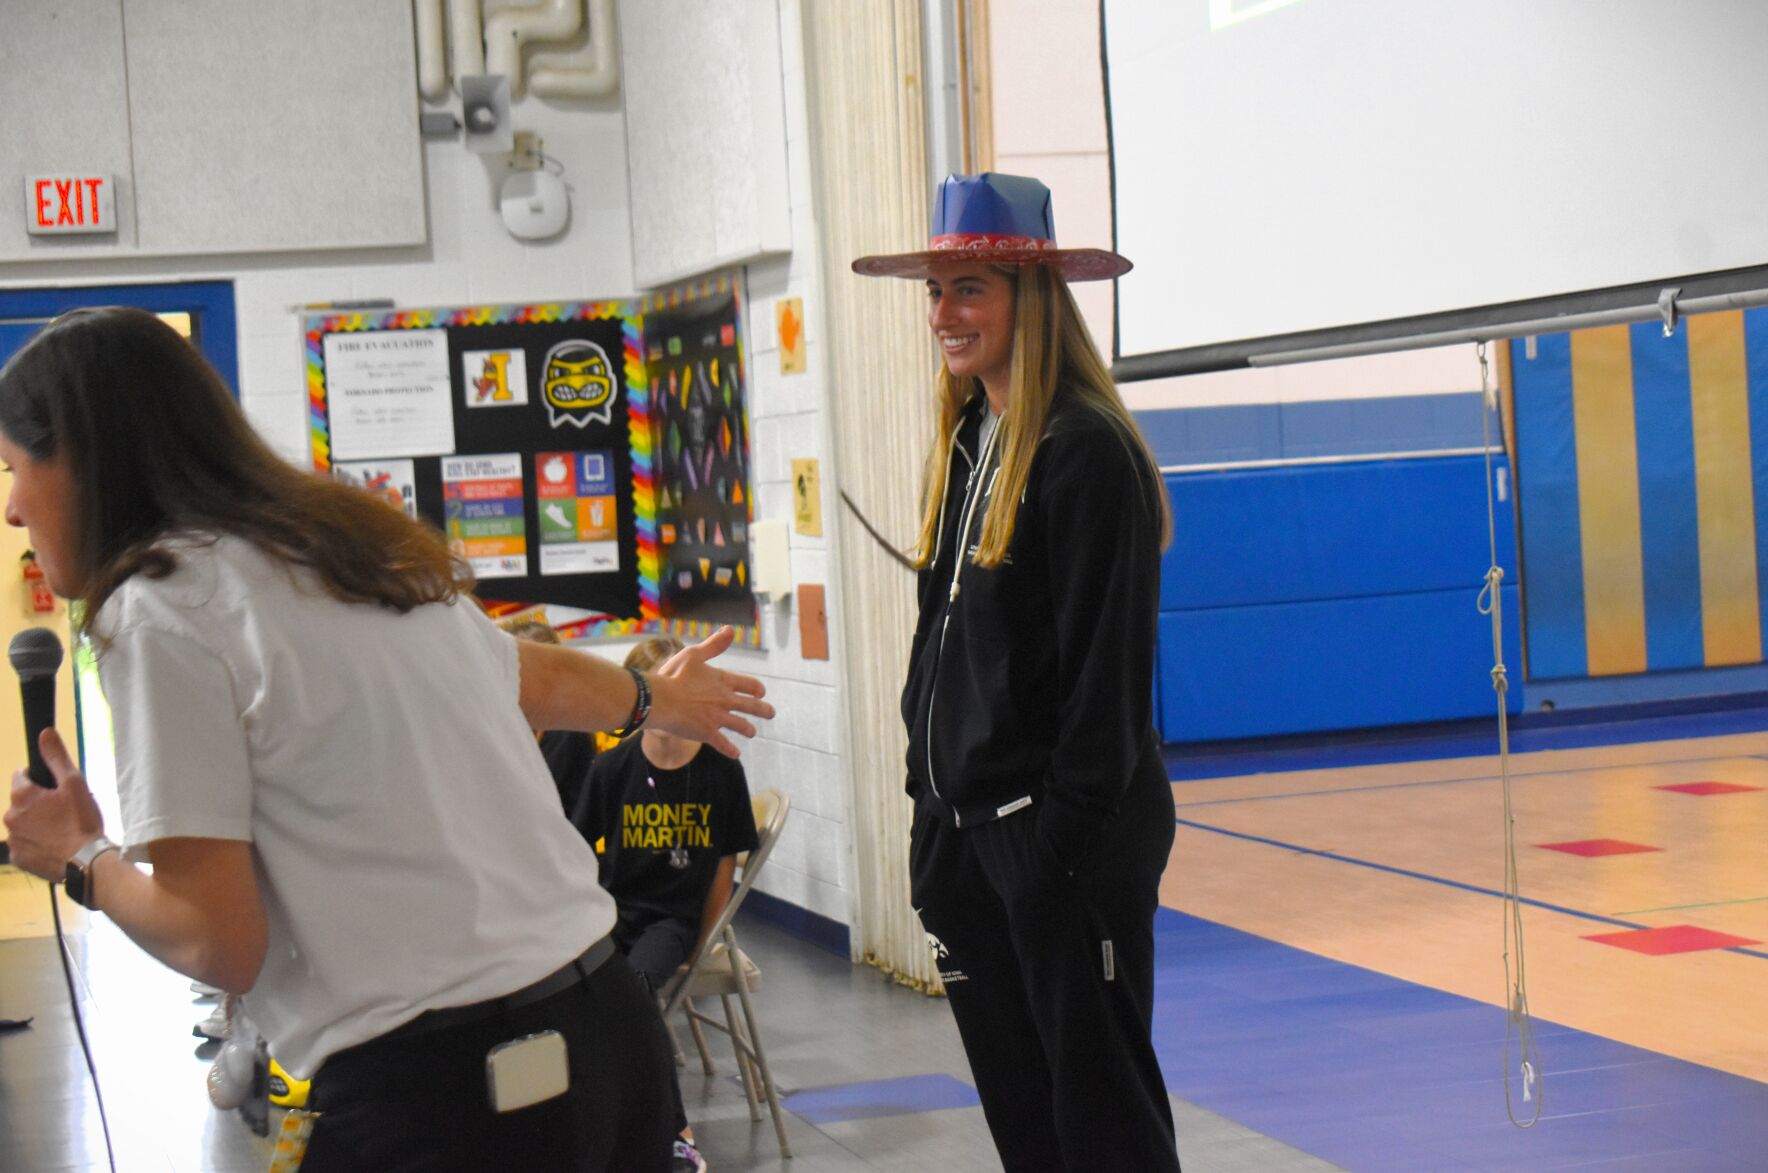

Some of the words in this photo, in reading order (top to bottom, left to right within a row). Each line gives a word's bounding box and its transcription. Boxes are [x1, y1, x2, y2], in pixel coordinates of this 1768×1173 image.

[35, 178, 103, 226] EXIT
[338, 342, 360, 353] FIRE
[365, 339, 434, 351] EVACUATION
[344, 388, 382, 397] TORNADO
[384, 385, 434, 395] PROTECTION
[623, 803, 712, 827] MONEY
